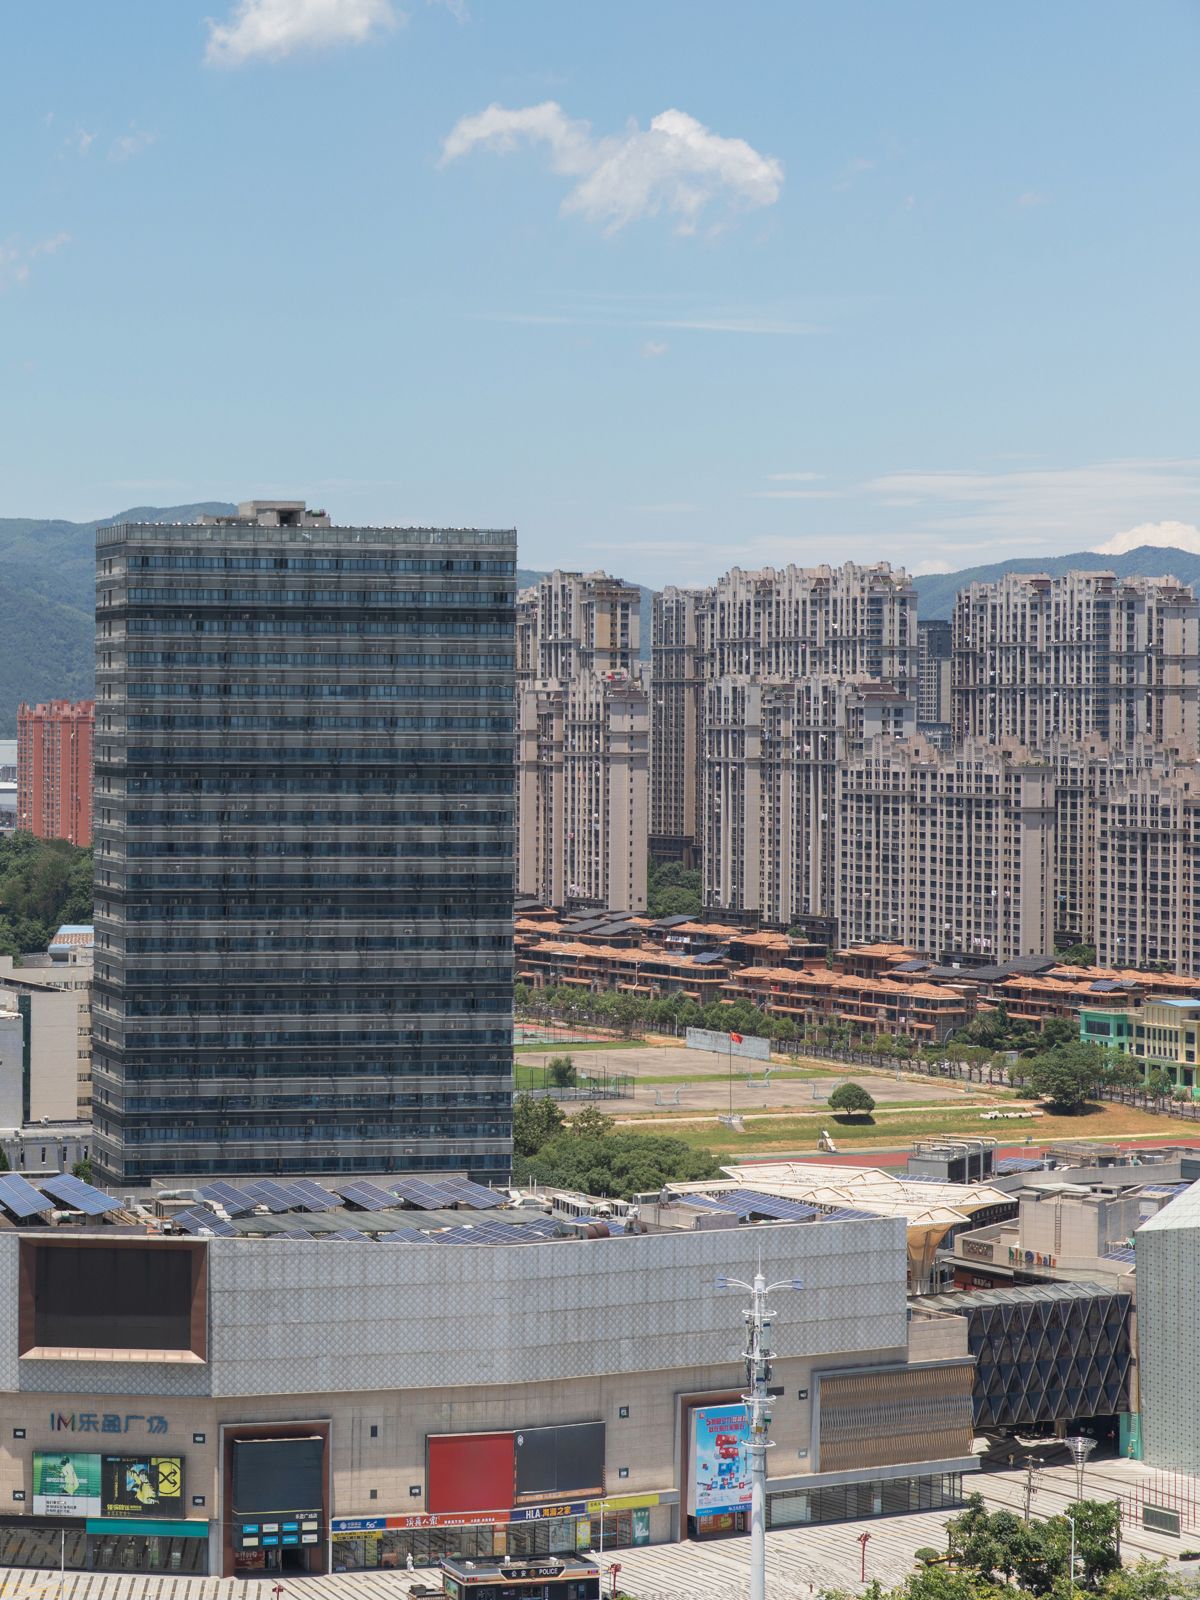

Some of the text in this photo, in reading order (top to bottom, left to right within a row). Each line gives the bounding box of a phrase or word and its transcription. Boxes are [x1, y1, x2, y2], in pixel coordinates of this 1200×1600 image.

[1036, 1252, 1057, 1268] hair
[525, 1506, 571, 1520] HLA 海澜之家
